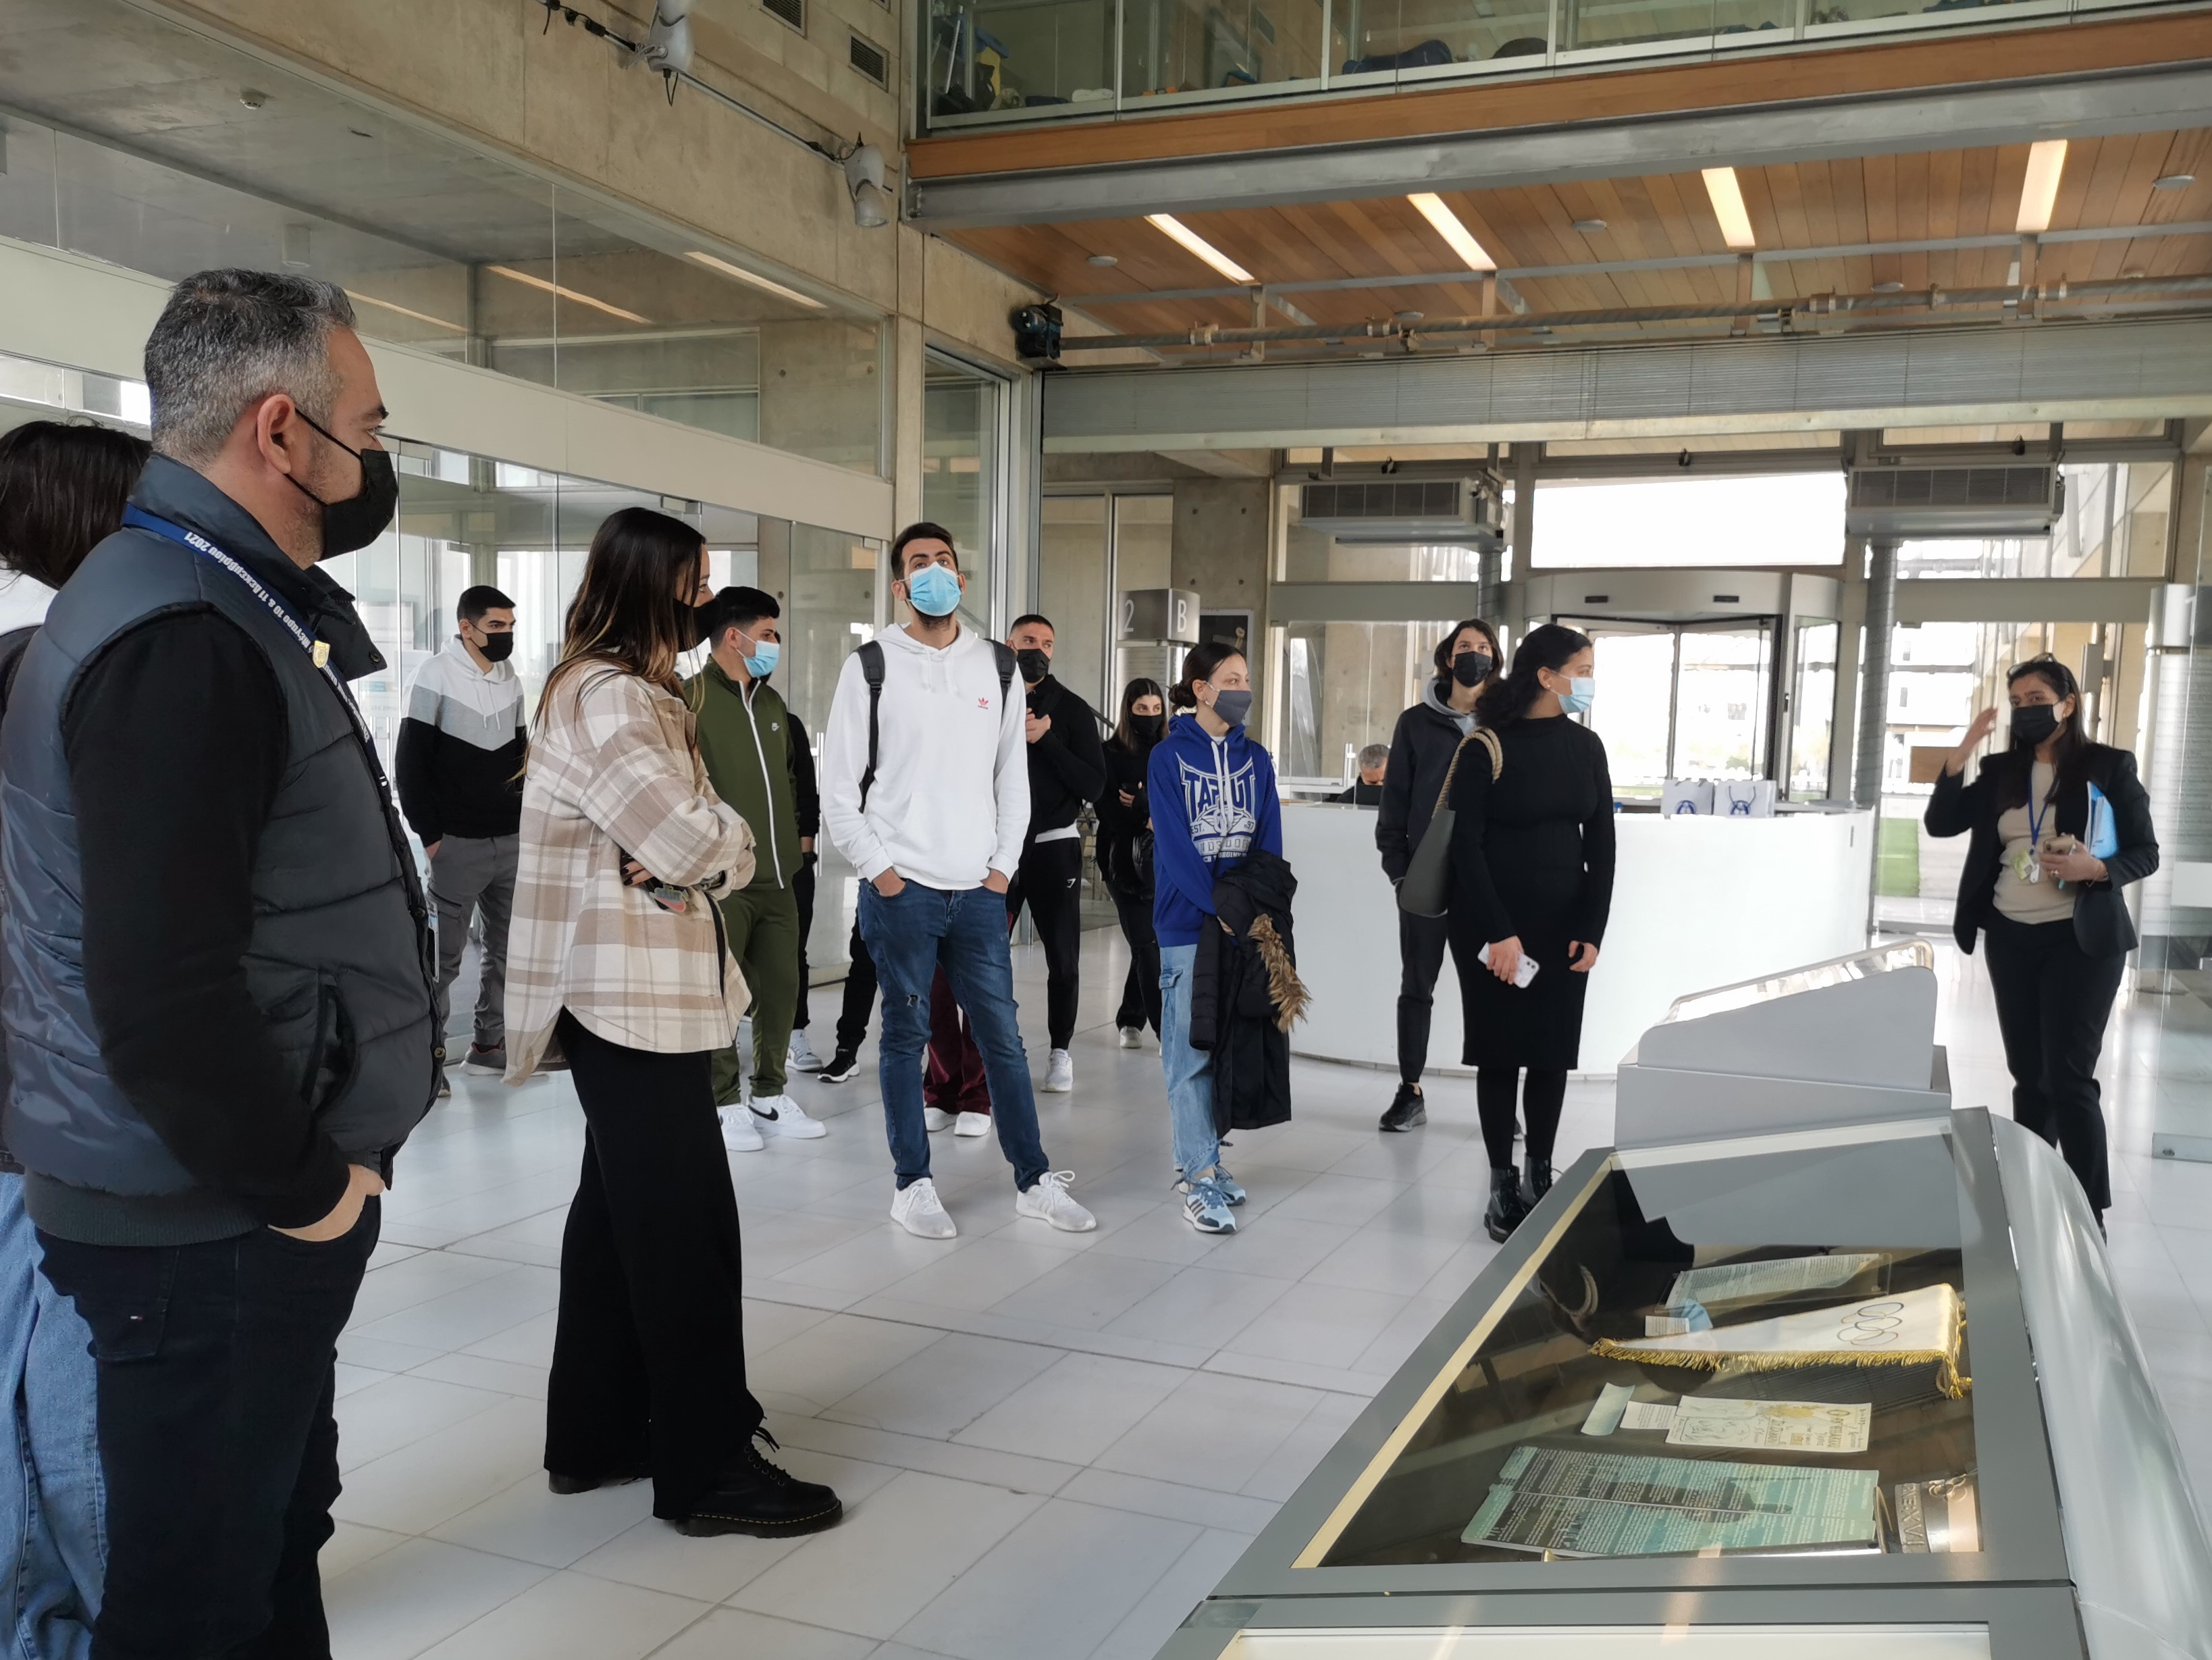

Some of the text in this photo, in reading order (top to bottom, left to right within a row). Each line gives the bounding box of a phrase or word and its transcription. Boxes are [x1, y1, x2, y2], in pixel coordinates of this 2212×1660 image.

[184, 531, 211, 552] 2021
[207, 546, 263, 594] Δεκεμβρίου
[258, 590, 269, 602] 11
[267, 598, 276, 607] &
[273, 606, 284, 618] 10
[1123, 599, 1134, 633] 2
[1177, 599, 1187, 633] B
[1183, 767, 1255, 822] TAPUT
[1190, 823, 1205, 834] EST.
